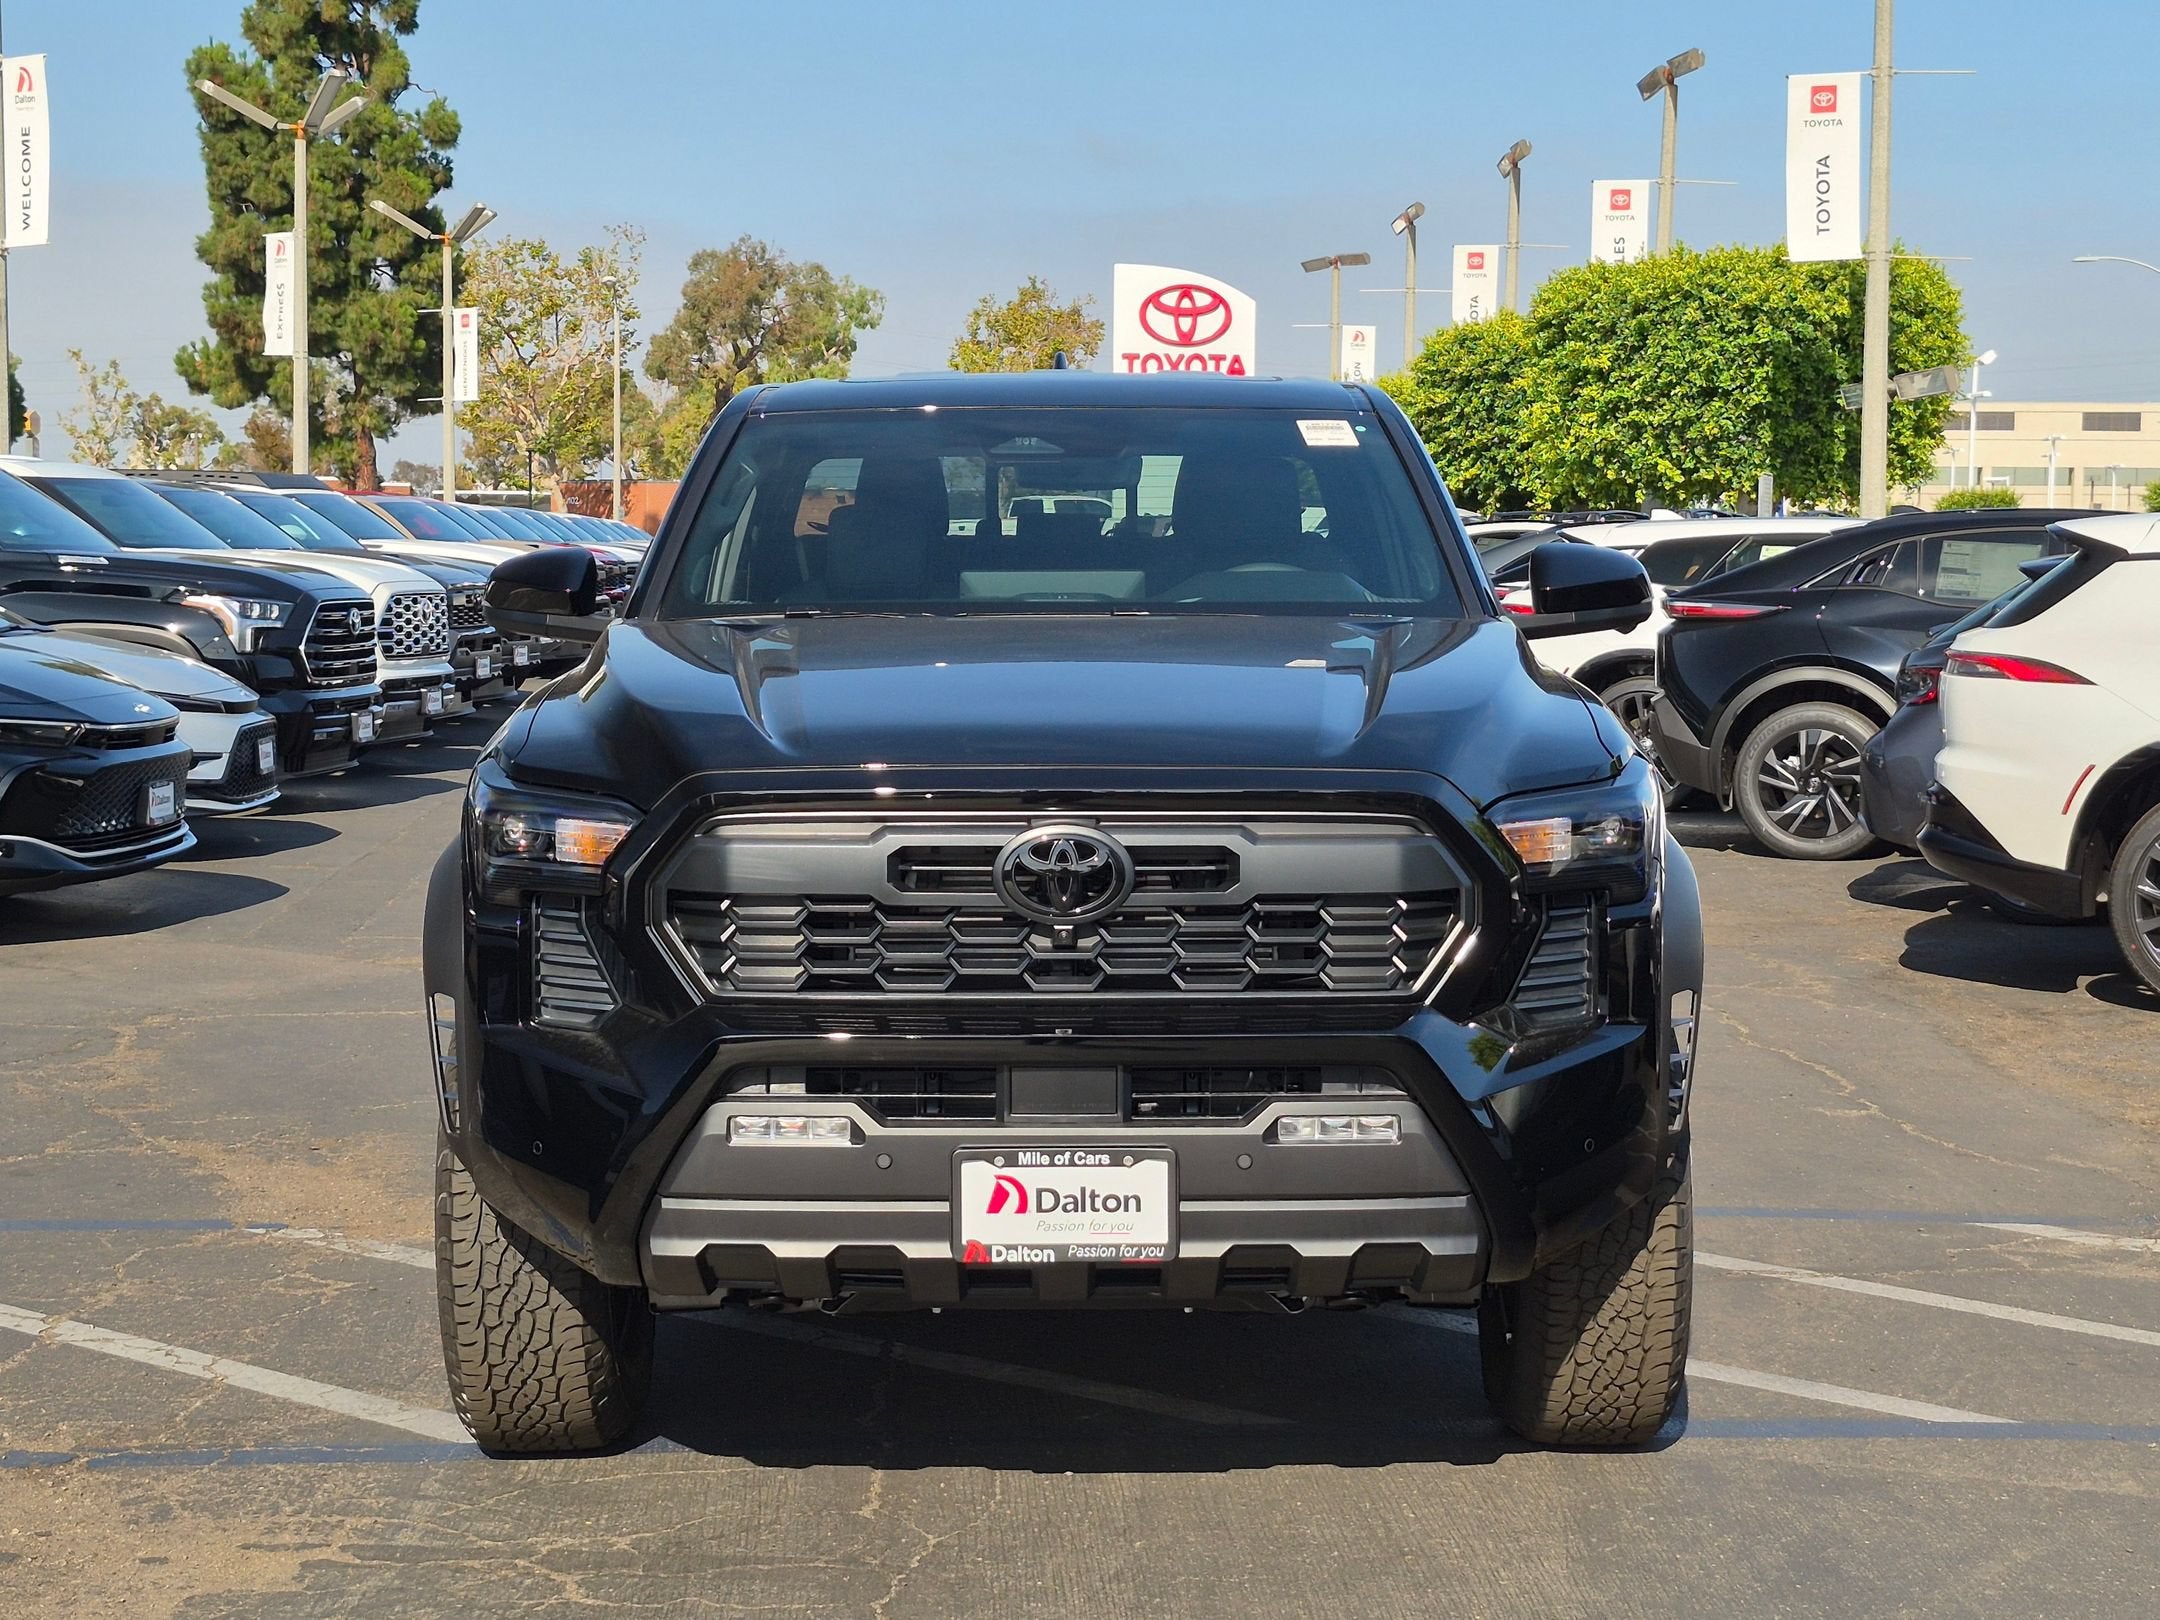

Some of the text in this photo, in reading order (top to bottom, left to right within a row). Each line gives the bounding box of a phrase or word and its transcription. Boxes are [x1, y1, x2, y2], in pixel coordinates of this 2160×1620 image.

[1804, 118, 1843, 127] TOYOTA
[21, 126, 32, 231] WELCOME
[1816, 154, 1831, 235] TOYOTA
[1614, 236, 1625, 263] LES
[1469, 295, 1479, 322] OTA
[1121, 353, 1246, 376] TOYOTA
[1018, 1151, 1110, 1165] Mile of Cars
[1036, 1186, 1141, 1213] Dalton
[1036, 1219, 1135, 1234] Passion for you
[991, 1244, 1165, 1262] Dalton Passion for you
